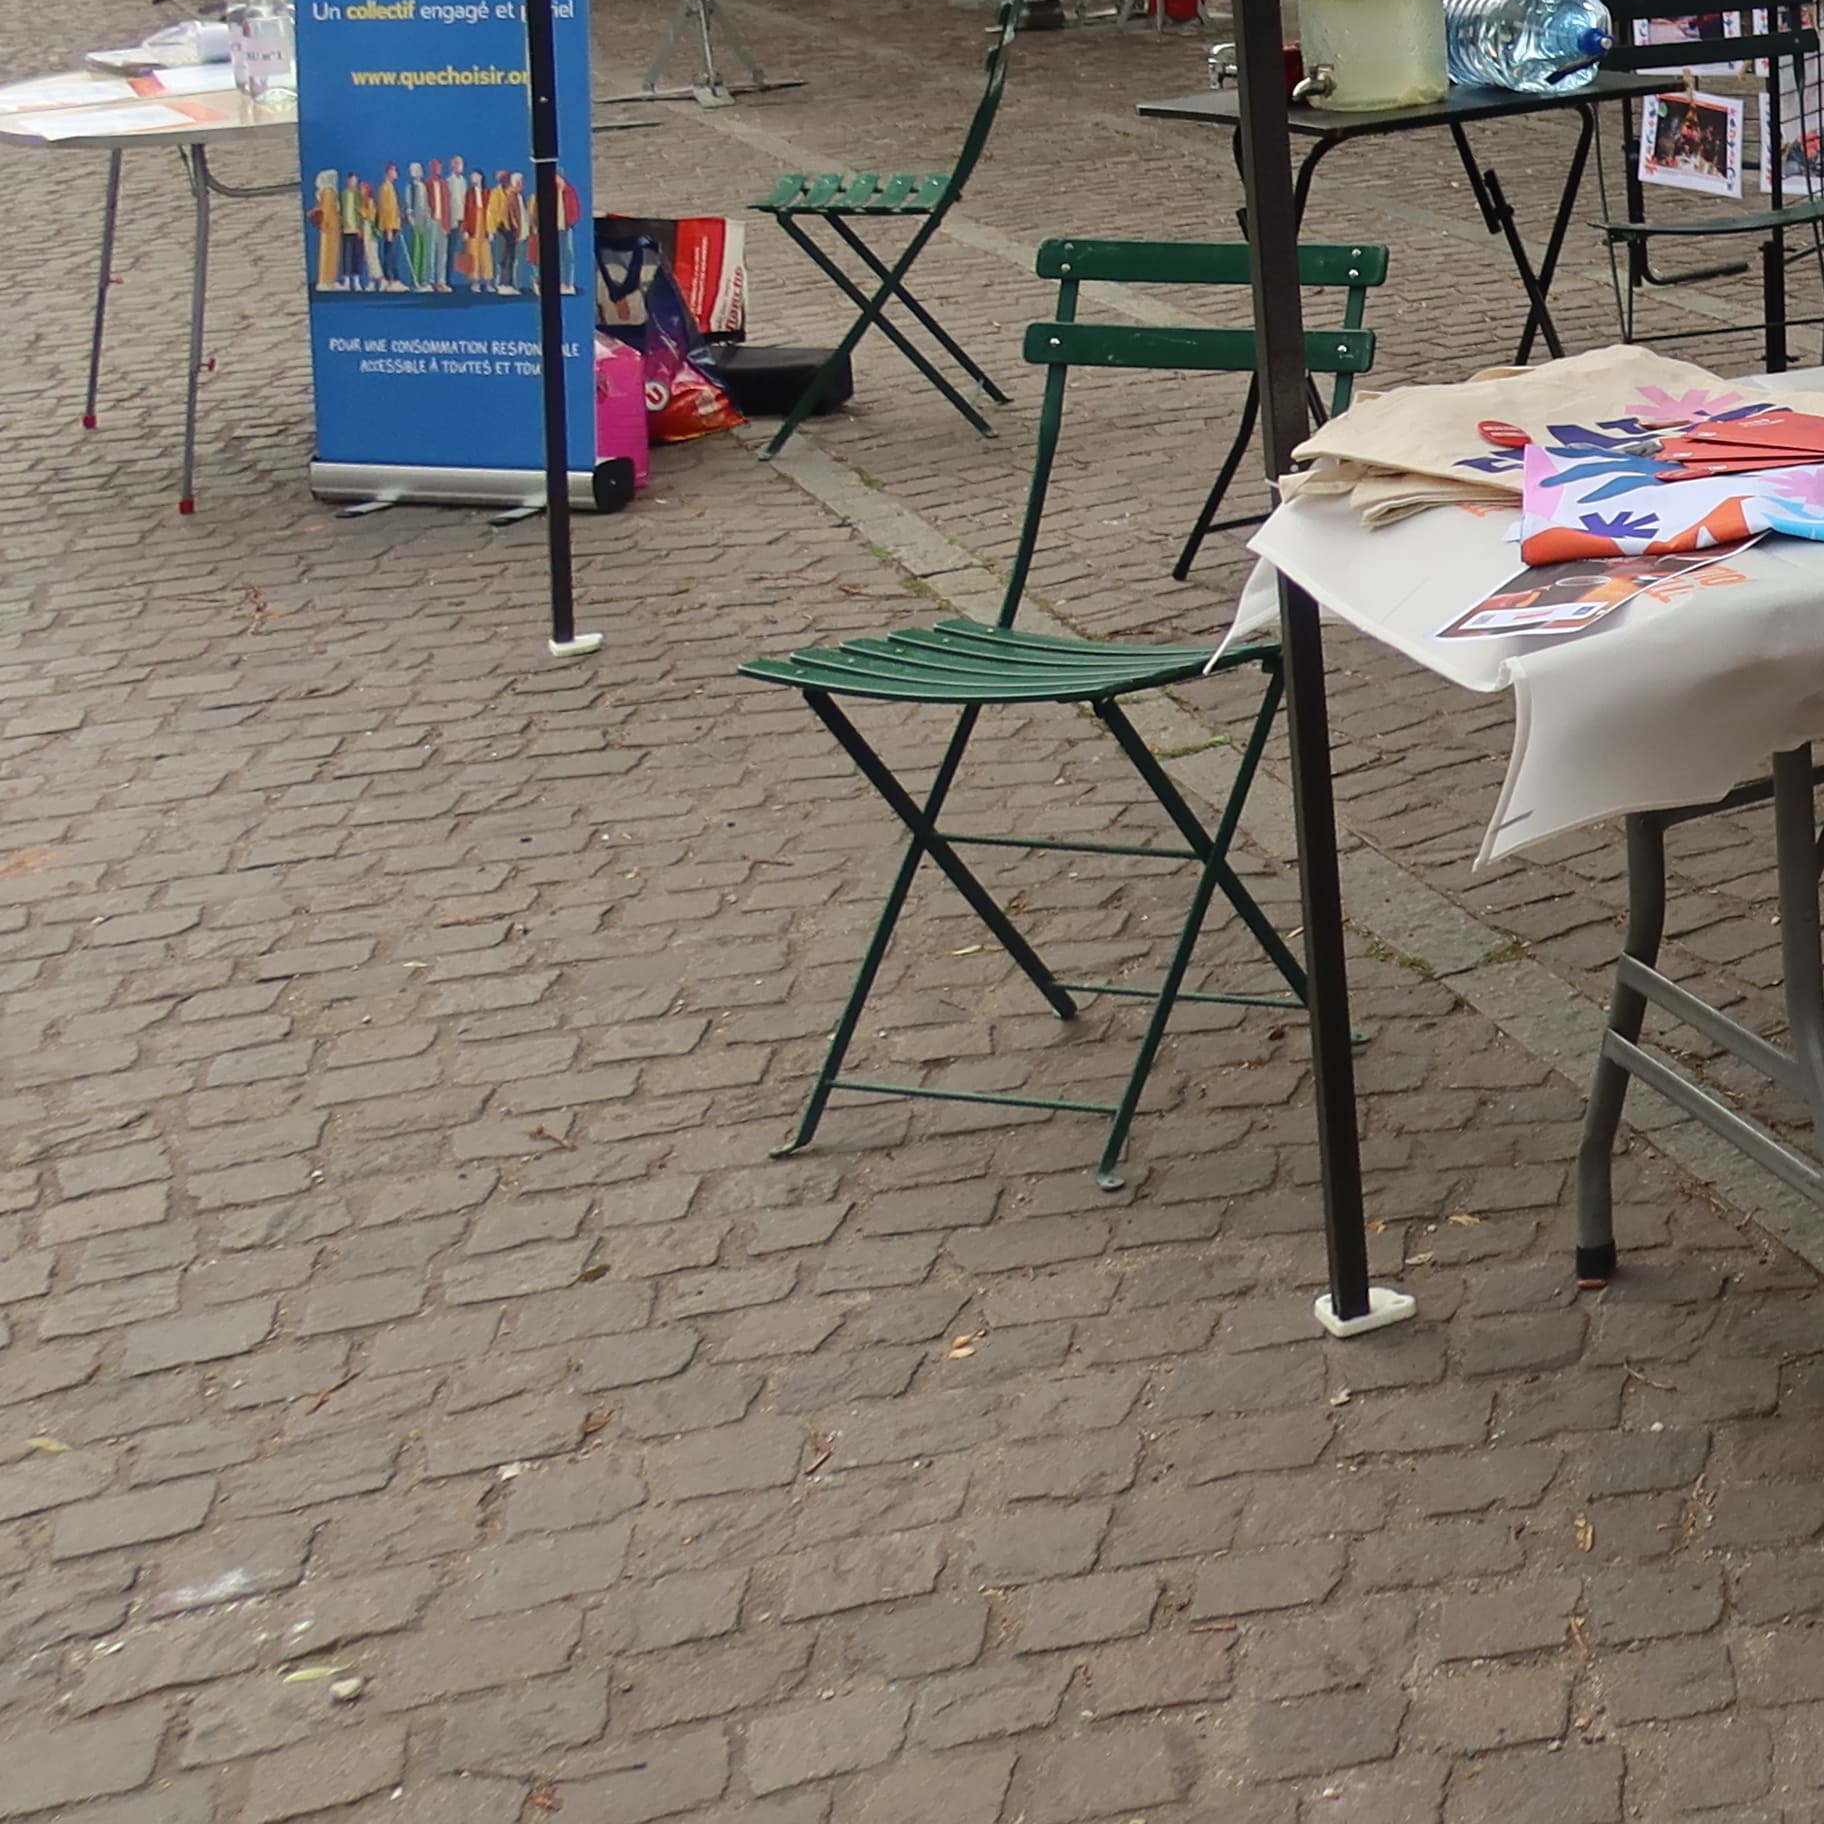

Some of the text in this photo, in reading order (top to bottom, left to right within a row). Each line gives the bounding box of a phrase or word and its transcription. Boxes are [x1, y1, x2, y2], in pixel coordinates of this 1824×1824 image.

[312, 2, 341, 21] Un
[346, 0, 417, 20] collectif
[420, 0, 489, 24] engagé
[495, 3, 515, 20] et
[351, 66, 530, 89] www.quechoisir.or
[329, 337, 362, 353] POUR
[364, 338, 388, 353] UNE
[391, 339, 489, 355] CONSOMMATION
[359, 359, 426, 374] ACCESSIBLE
[441, 360, 492, 376] TOUTES
[495, 360, 511, 375] ET
[514, 361, 543, 376] TOU
